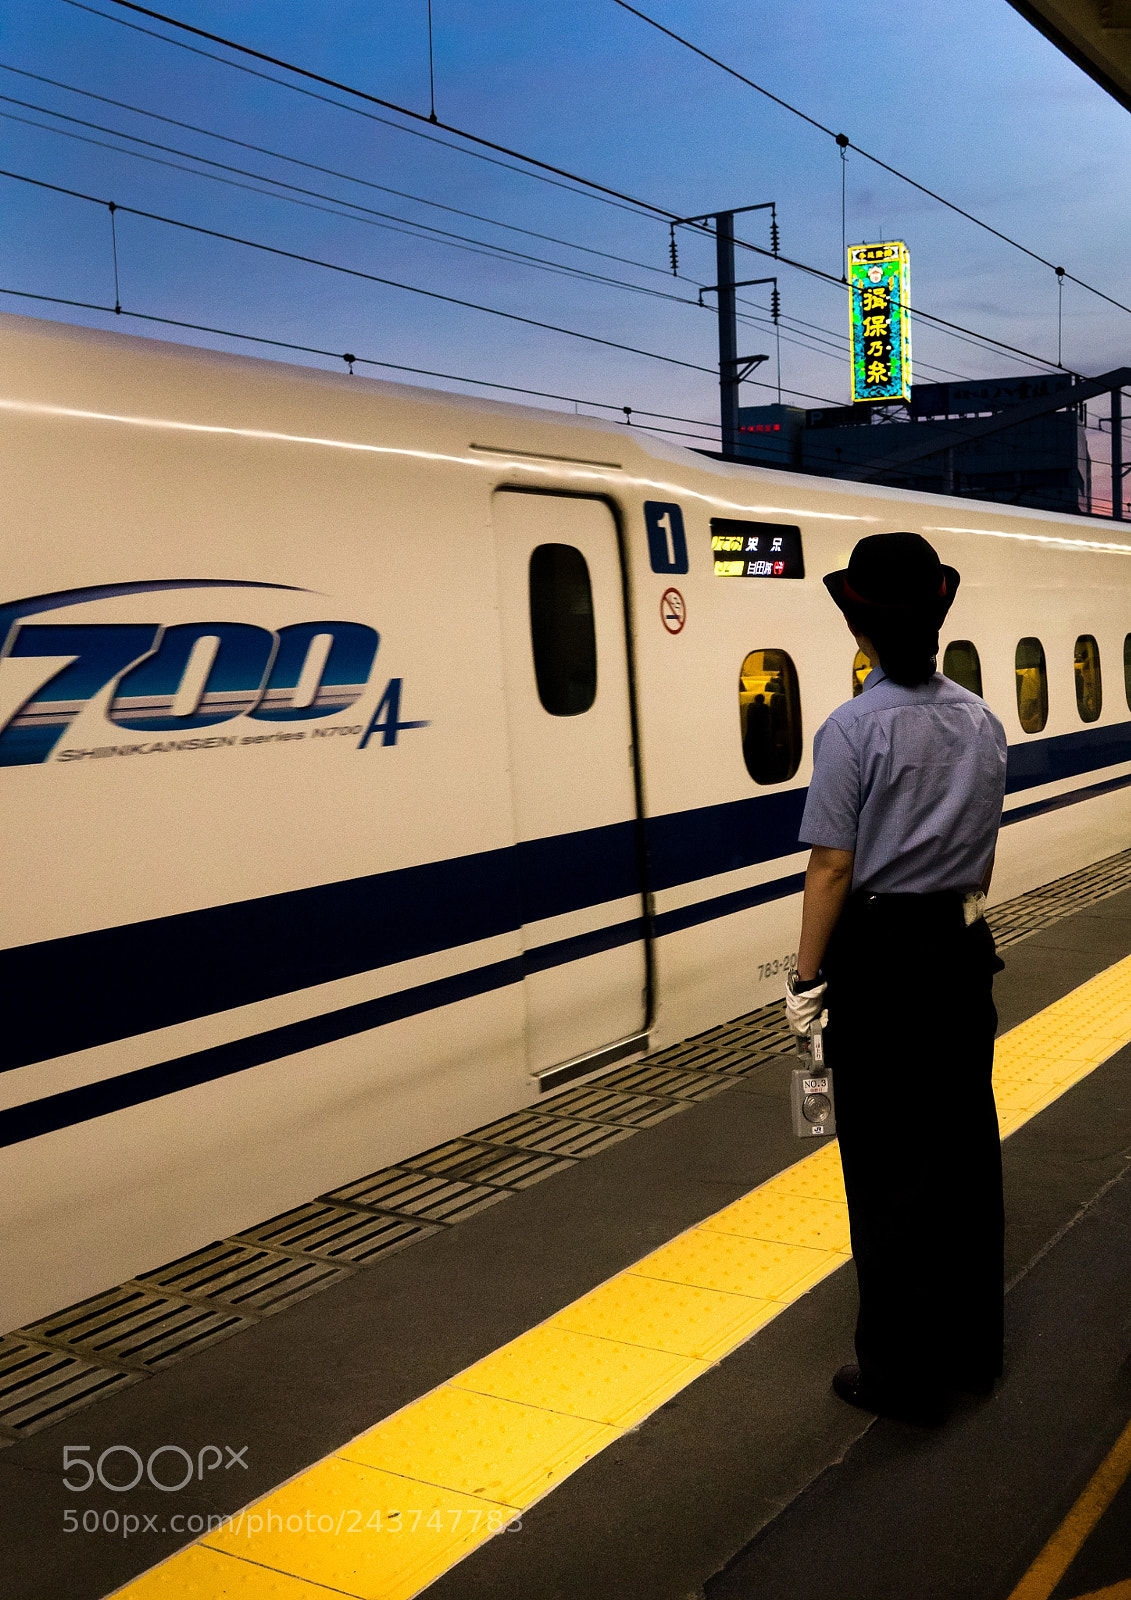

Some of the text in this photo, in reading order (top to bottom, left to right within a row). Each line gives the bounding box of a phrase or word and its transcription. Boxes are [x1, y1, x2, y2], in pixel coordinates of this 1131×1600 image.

[656, 512, 676, 565] 1
[57, 735, 238, 763] SHINKANSEN
[240, 730, 306, 746] series
